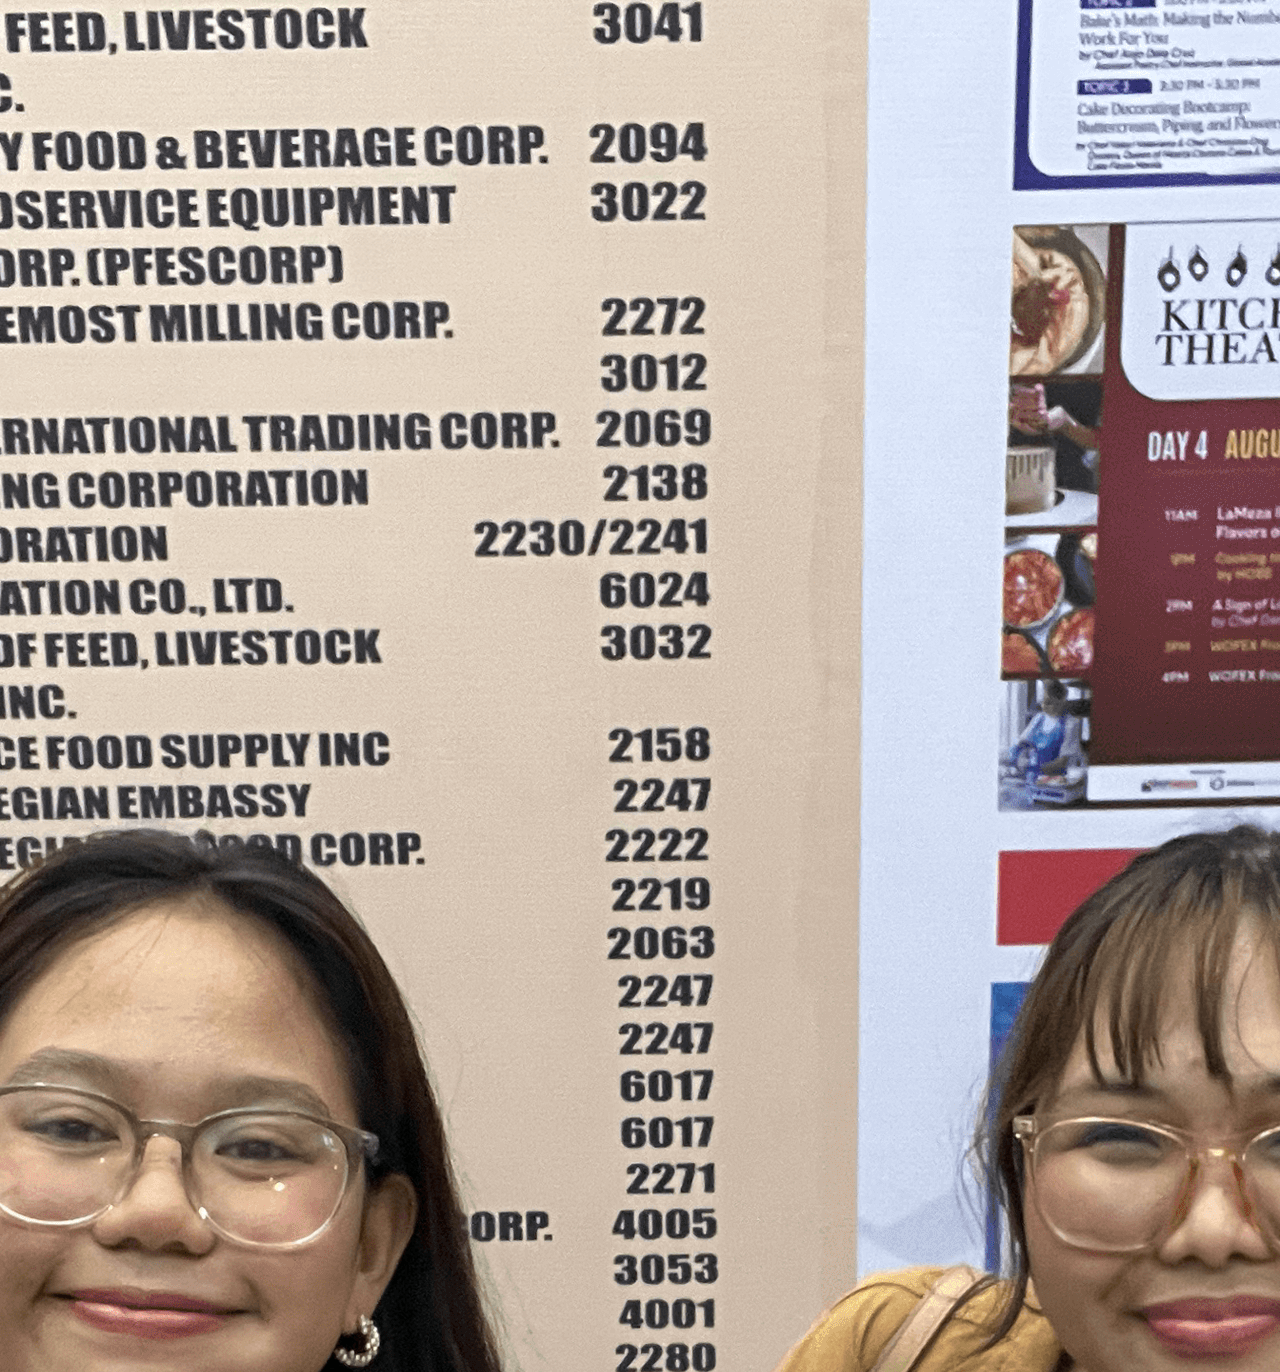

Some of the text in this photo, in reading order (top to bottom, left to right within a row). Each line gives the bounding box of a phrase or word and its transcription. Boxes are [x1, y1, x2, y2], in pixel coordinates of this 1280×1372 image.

[5, 12, 117, 55] FEED,
[124, 8, 369, 51] LIVESTOCK
[594, 2, 702, 44] 3041
[32, 131, 146, 171] FOOD
[156, 137, 187, 170] &
[194, 127, 416, 169] BEVERAGE
[424, 126, 548, 166] CORP.
[590, 122, 707, 163] 2094
[207, 185, 456, 231] EQUIPMENT
[87, 245, 343, 286] (PFESCORP)
[149, 302, 323, 342] MILLING
[332, 301, 453, 340] CORP.
[242, 413, 431, 452] TRADING
[440, 412, 560, 449] CORP.
[1147, 431, 1190, 461] DAY
[1193, 430, 1209, 460] 4
[68, 469, 368, 509] CORPORATION
[46, 735, 152, 770] FOOD
[160, 733, 310, 769] SUPPLY
[319, 732, 390, 766] INC
[117, 784, 311, 819] EMBASSY
[614, 778, 711, 812] 2247
[612, 1209, 717, 1240] 4005
[614, 1253, 718, 1285] 3053
